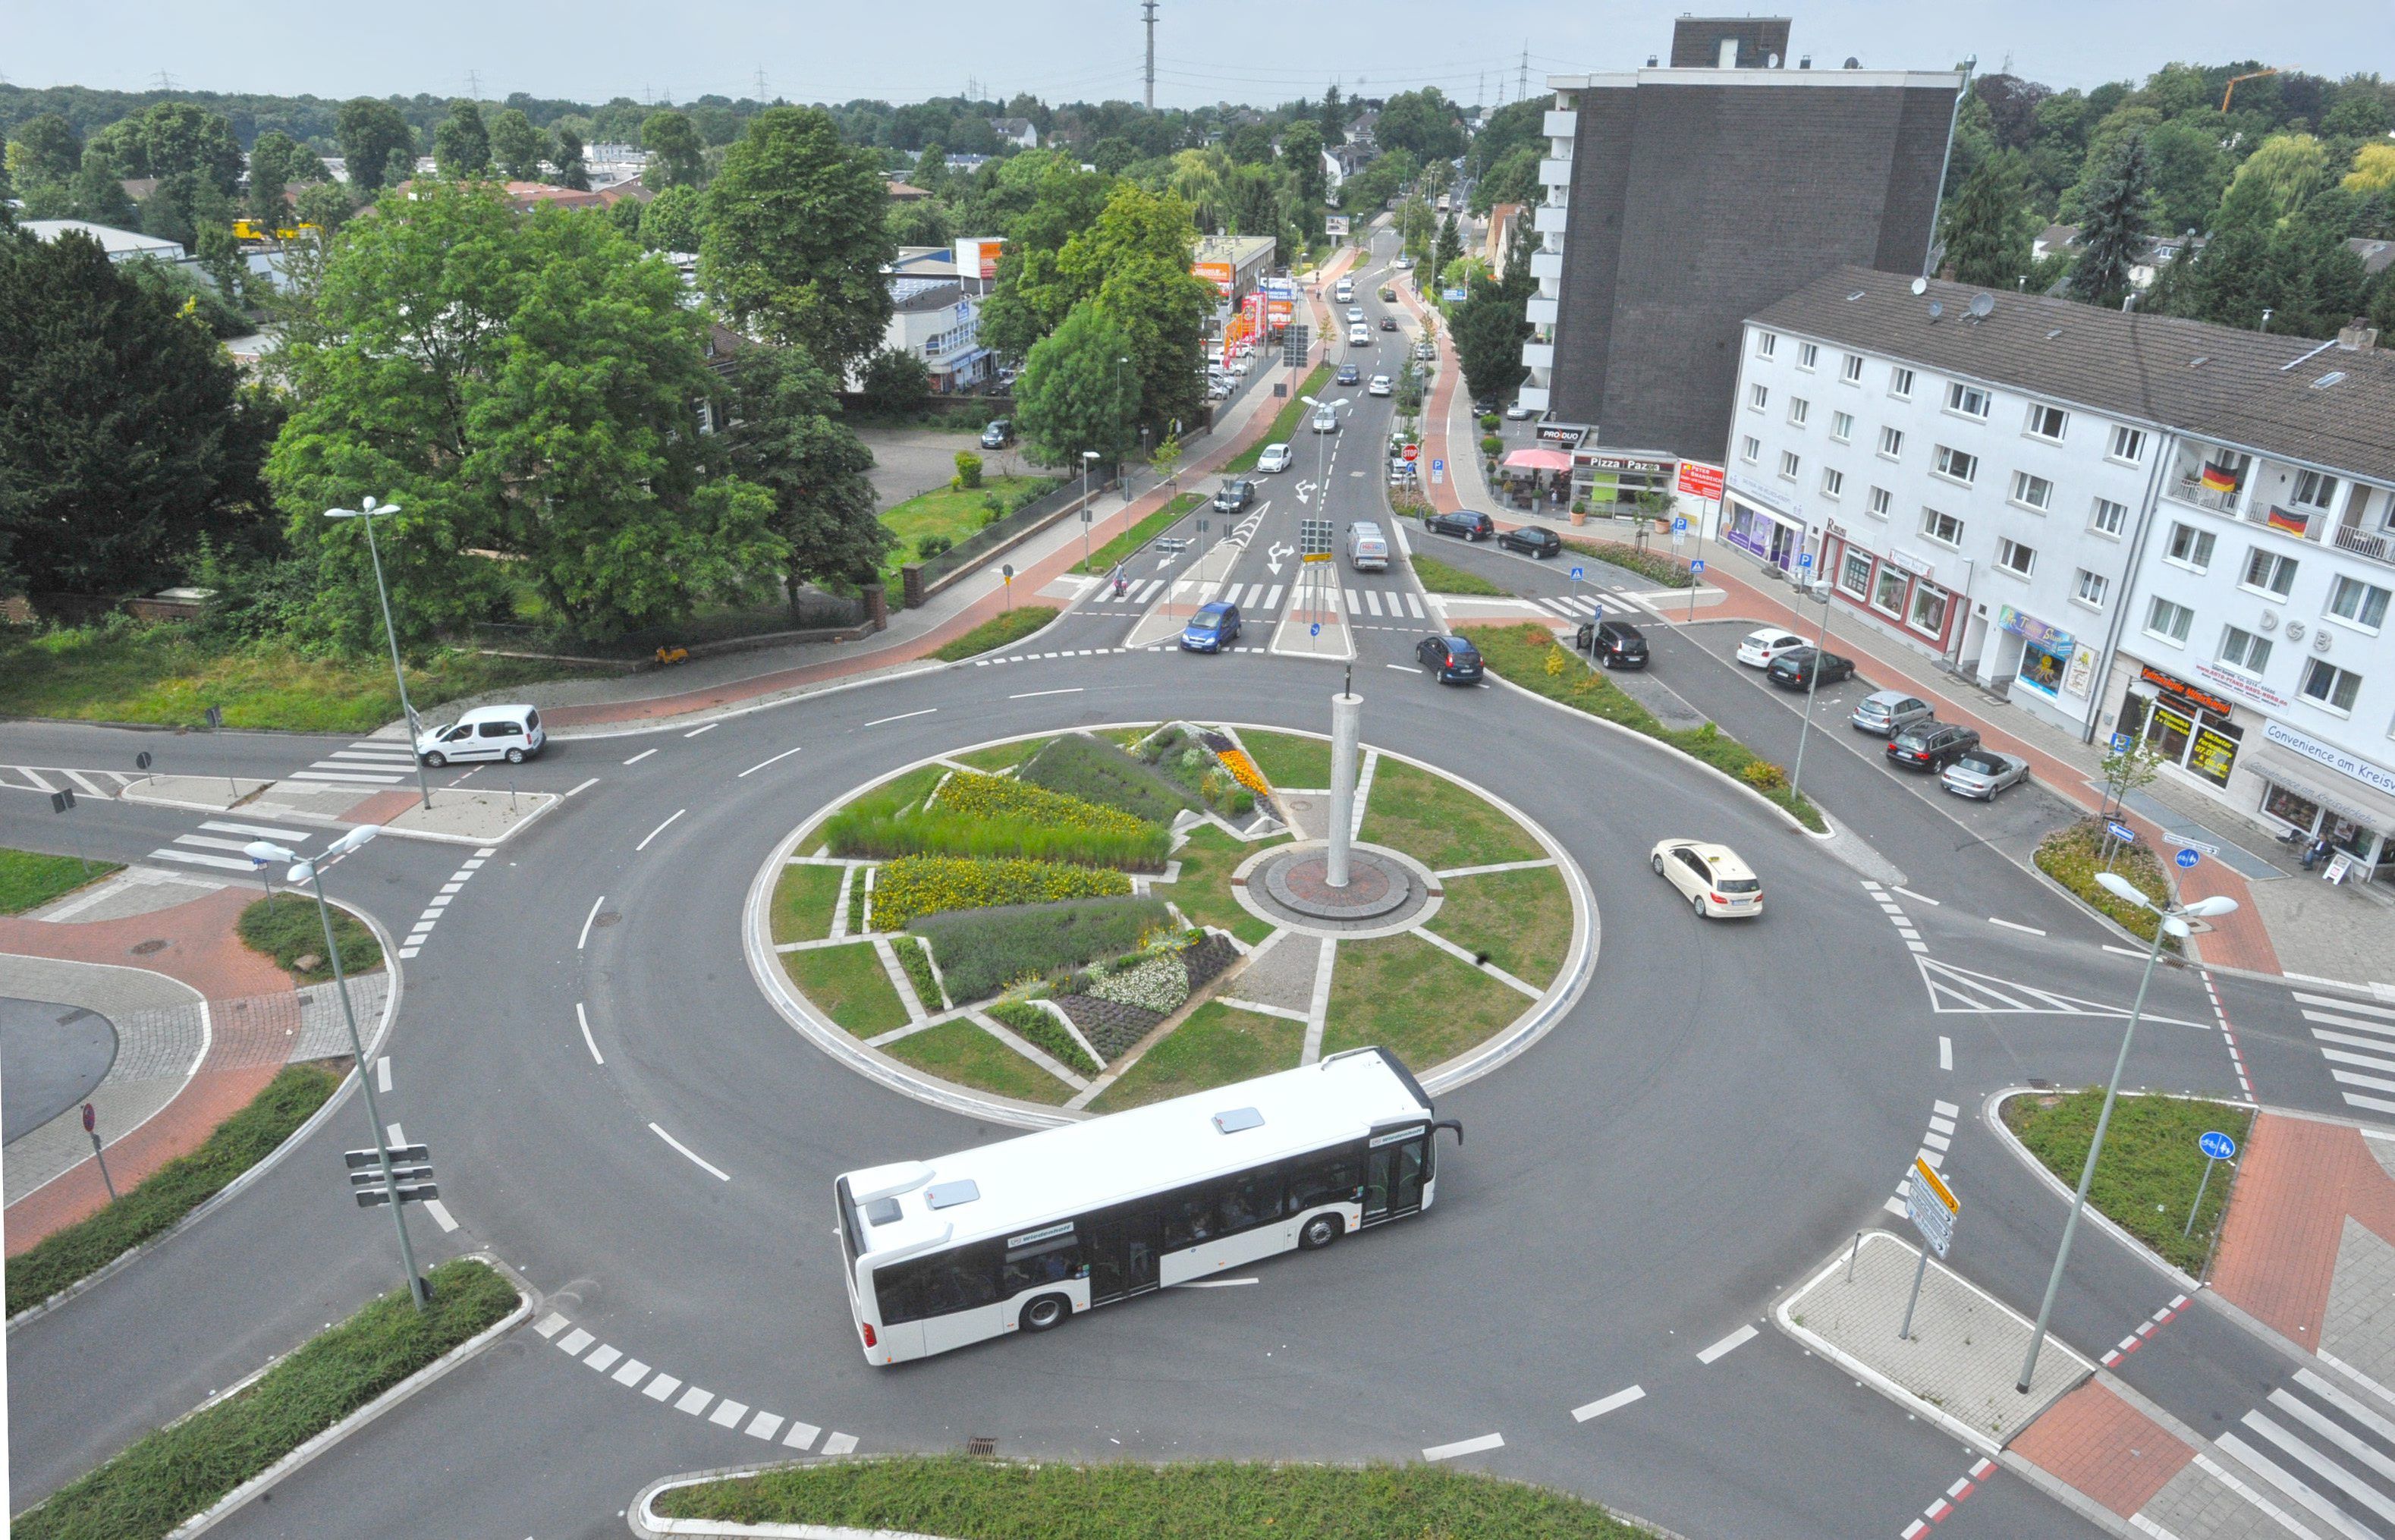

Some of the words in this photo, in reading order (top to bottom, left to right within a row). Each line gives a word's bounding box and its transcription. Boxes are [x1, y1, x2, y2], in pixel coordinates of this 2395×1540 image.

[1543, 430, 1560, 438] PRO
[1590, 457, 1620, 468] Pizza
[1802, 555, 1809, 564] P
[2268, 725, 2334, 763] Convenience
[2337, 758, 2354, 772] am
[2250, 762, 2301, 790] Convenience
[2300, 786, 2315, 797] am
[2316, 793, 2378, 825] Kreisverkehr
[1023, 1225, 1070, 1242] Wiedenhoff
